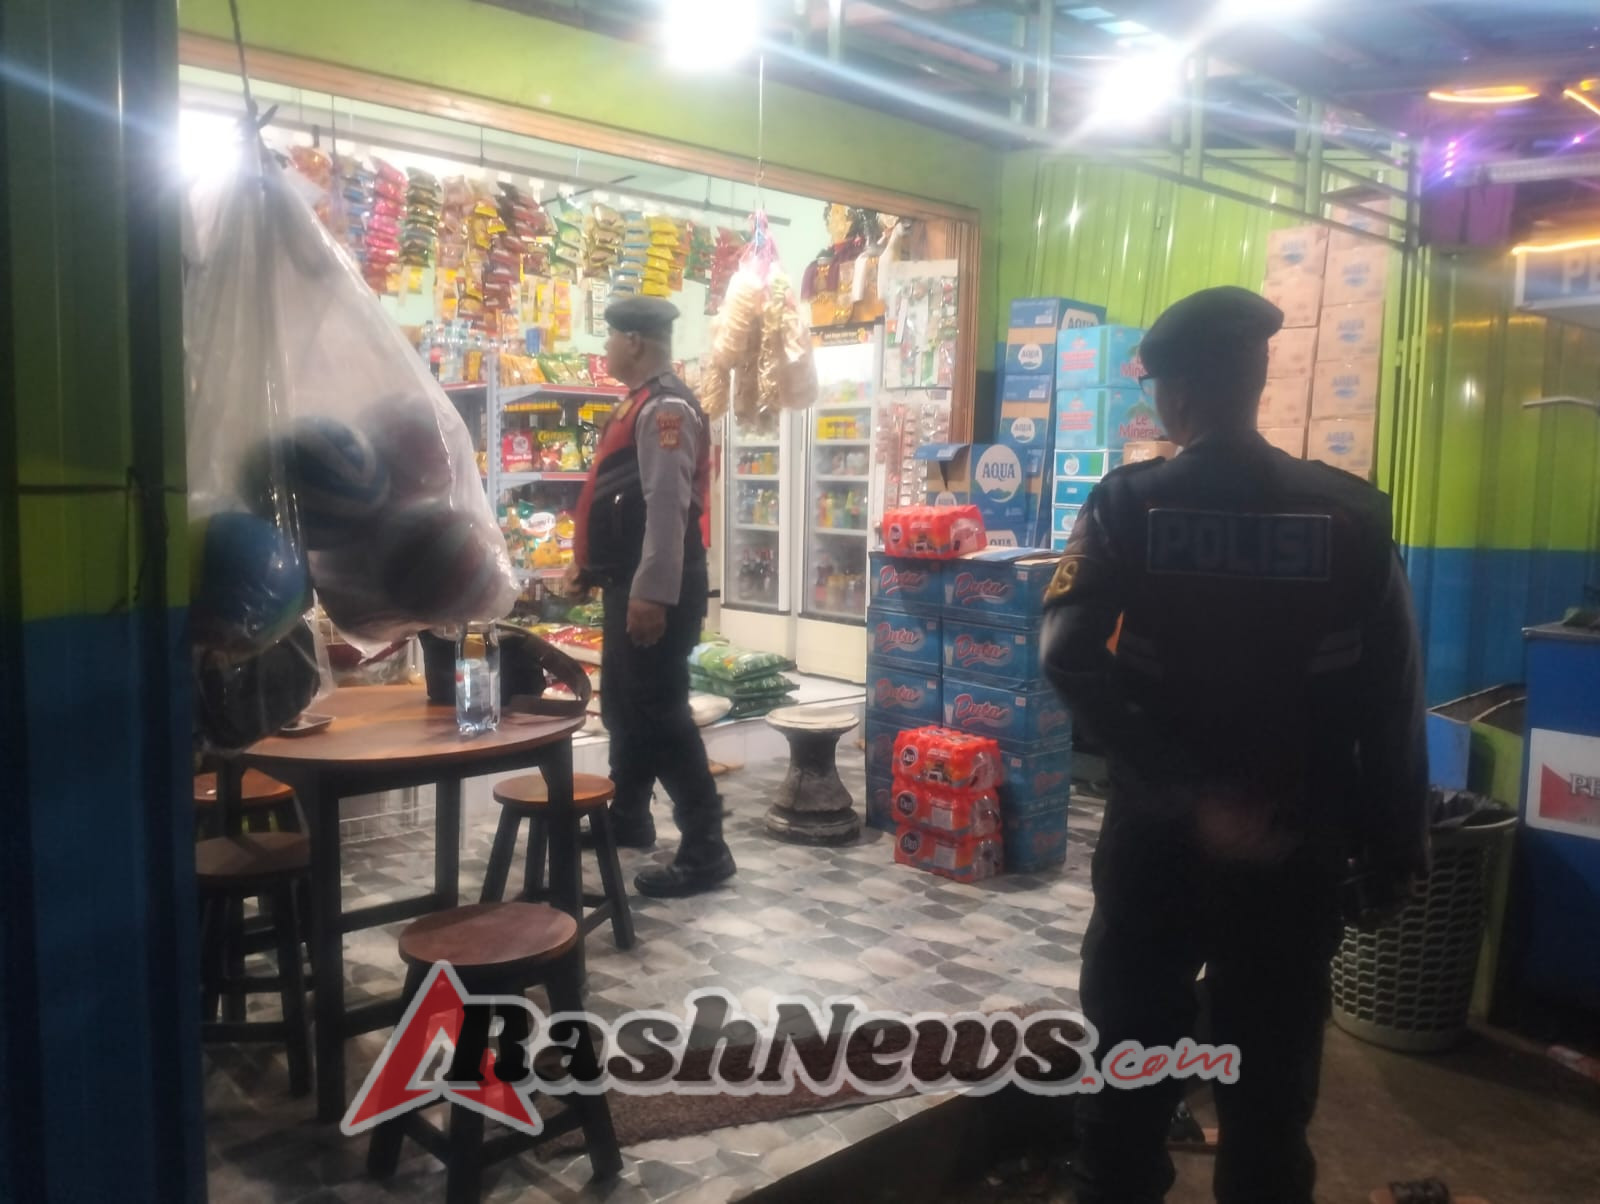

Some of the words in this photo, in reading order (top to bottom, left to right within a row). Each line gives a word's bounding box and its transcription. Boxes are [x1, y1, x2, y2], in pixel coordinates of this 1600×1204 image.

[1014, 423, 1032, 432] AQUA
[982, 462, 1015, 481] AQUA
[1157, 515, 1323, 572] POLISI
